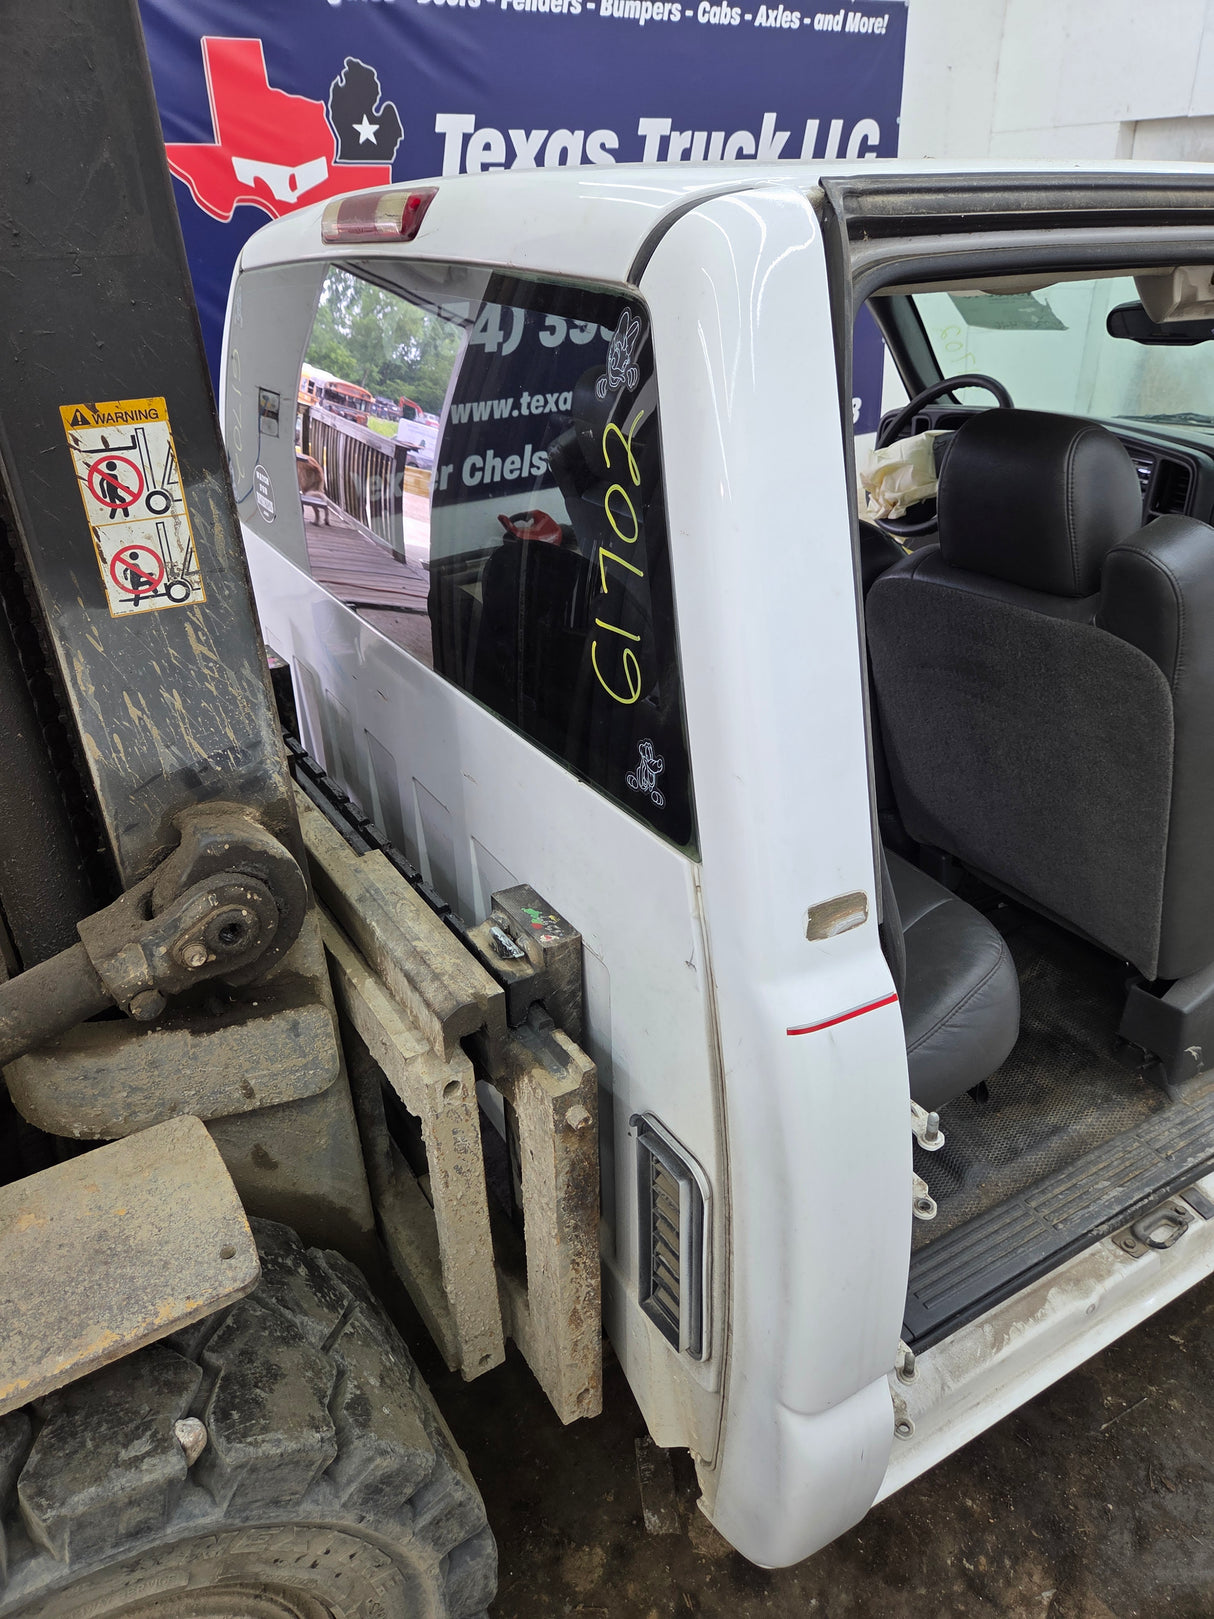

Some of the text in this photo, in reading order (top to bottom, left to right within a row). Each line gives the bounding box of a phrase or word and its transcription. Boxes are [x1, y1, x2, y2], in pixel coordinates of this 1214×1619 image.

[599, 0, 682, 26] Bumpers
[697, 1, 742, 25] Cabs
[754, 5, 801, 29] Axles
[813, 9, 846, 33] and
[845, 12, 890, 35] More!
[434, 113, 620, 176] Texas
[637, 112, 791, 163] Truck
[91, 407, 160, 426] WARNING
[461, 444, 553, 487] Chels
